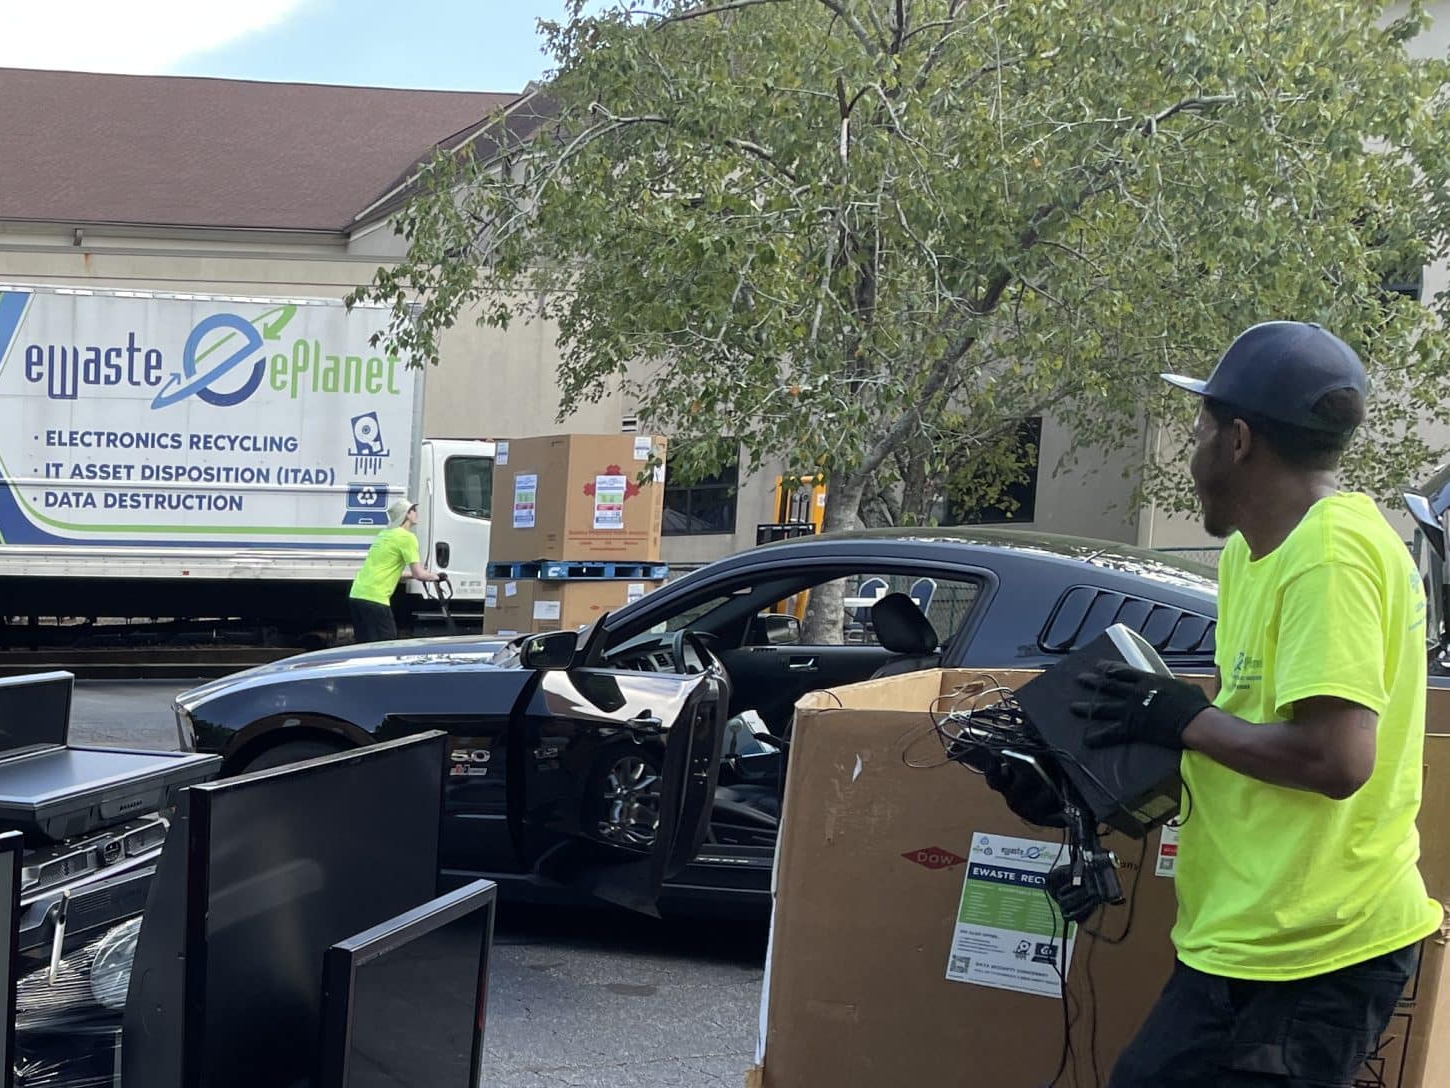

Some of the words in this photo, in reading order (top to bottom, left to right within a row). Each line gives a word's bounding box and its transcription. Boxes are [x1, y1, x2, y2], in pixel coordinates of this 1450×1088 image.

[270, 338, 402, 398] ePlanet
[45, 430, 183, 450] ELECTRONICS
[189, 434, 299, 453] RECYCLING
[45, 462, 64, 480] IT
[70, 464, 135, 481] ASSET
[141, 465, 271, 484] DISPOSITION
[276, 467, 336, 486] (ITAD)
[44, 491, 97, 510] DATA
[103, 492, 244, 512] DESTRUCTION
[451, 749, 490, 762] 5.0
[972, 867, 1016, 881] EWASTE
